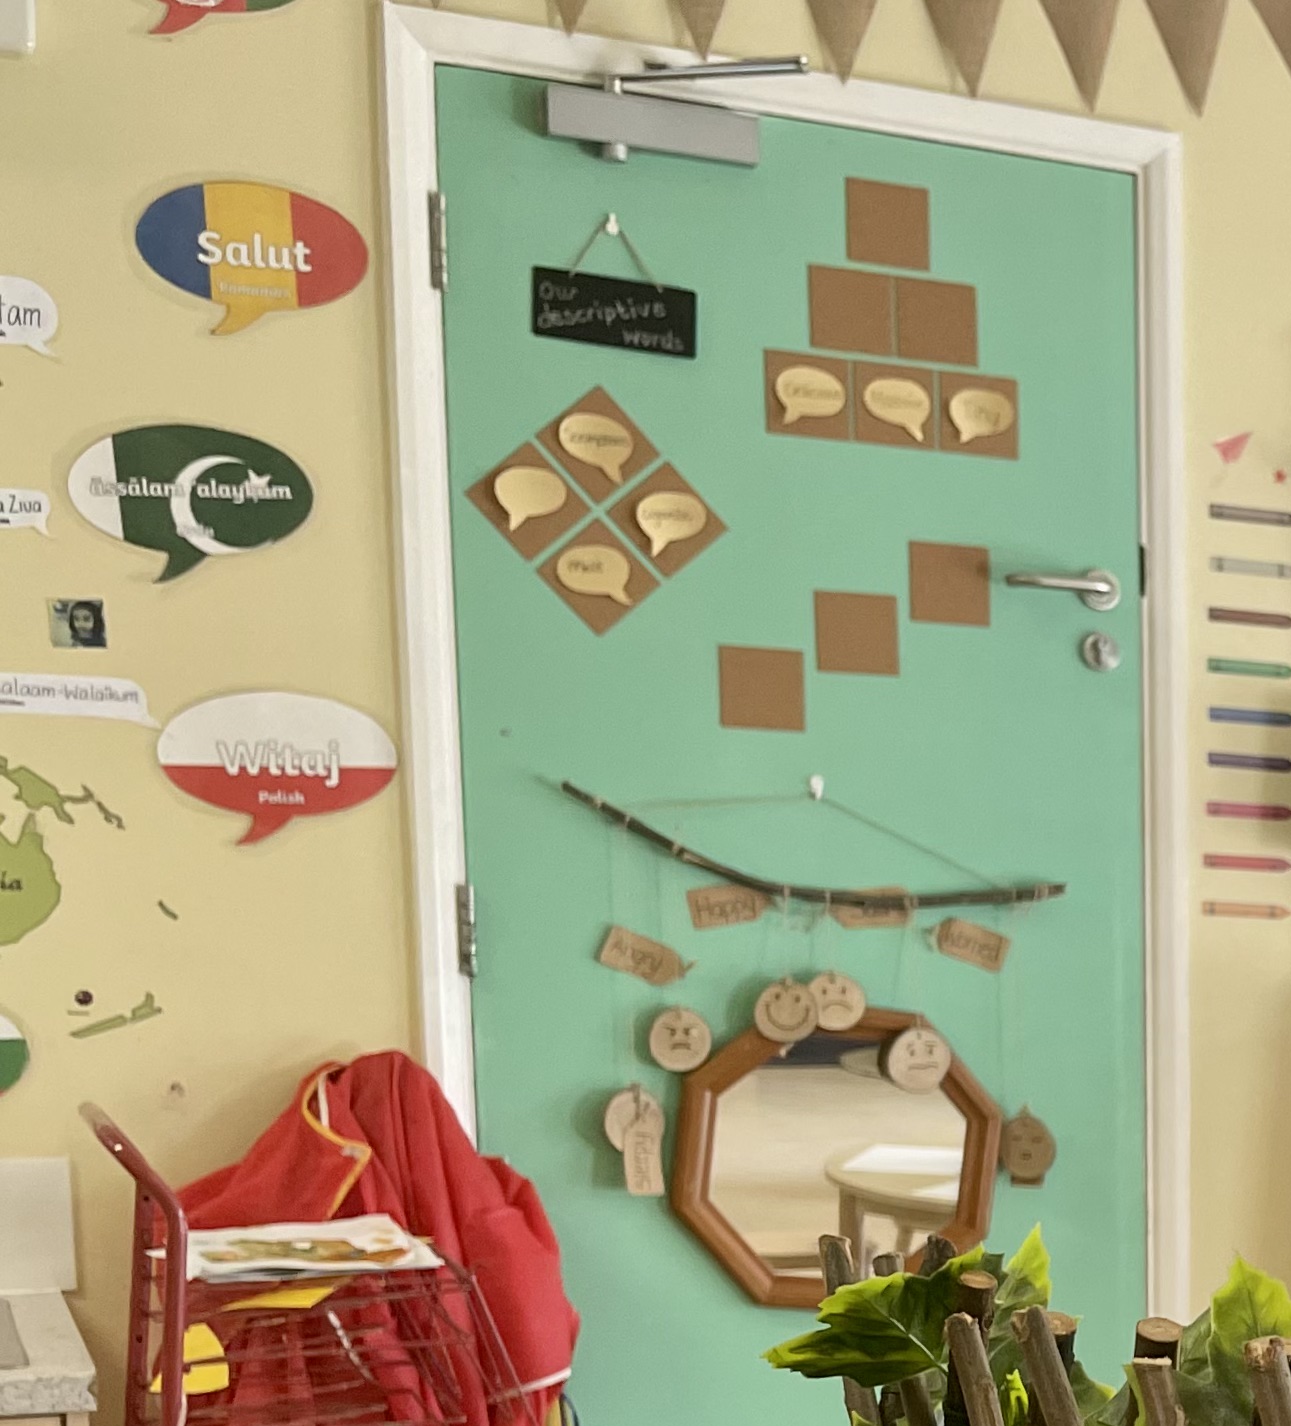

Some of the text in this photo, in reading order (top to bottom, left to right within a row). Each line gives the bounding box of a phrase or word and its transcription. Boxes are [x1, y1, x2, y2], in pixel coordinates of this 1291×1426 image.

[197, 230, 312, 273] Salut
[537, 297, 667, 330] descriptive
[216, 738, 341, 789] Witaj
[258, 788, 306, 806] Polish
